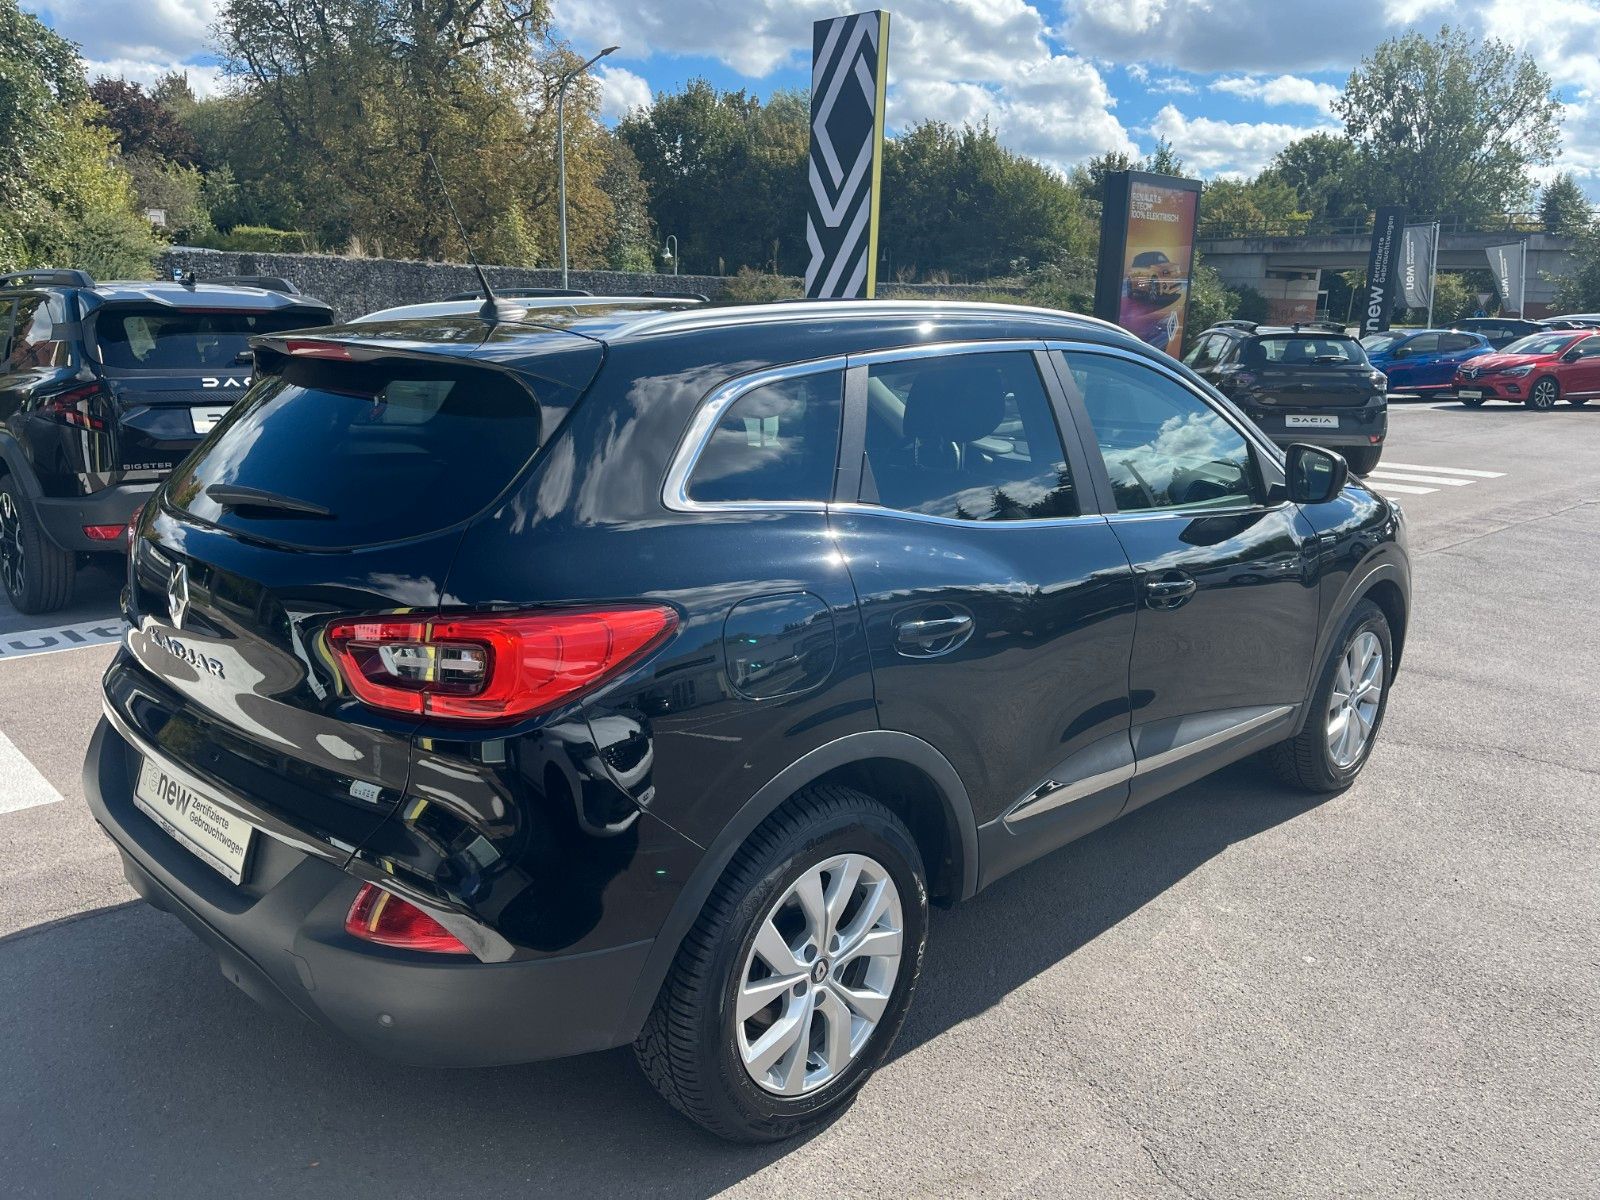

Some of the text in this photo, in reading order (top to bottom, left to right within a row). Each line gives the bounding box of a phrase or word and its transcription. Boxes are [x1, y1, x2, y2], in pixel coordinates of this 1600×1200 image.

[1130, 210, 1145, 219] 100%
[1373, 237, 1385, 283] Zertifizierte
[1379, 215, 1395, 283] Gebrauchtwagen
[1365, 285, 1384, 335] new
[122, 462, 172, 470] BIGSTER
[0, 627, 122, 654] ult
[149, 626, 226, 680] KADJAR
[189, 812, 244, 857] Gebrauchtwagen
[192, 797, 229, 830] Zertifizierte
